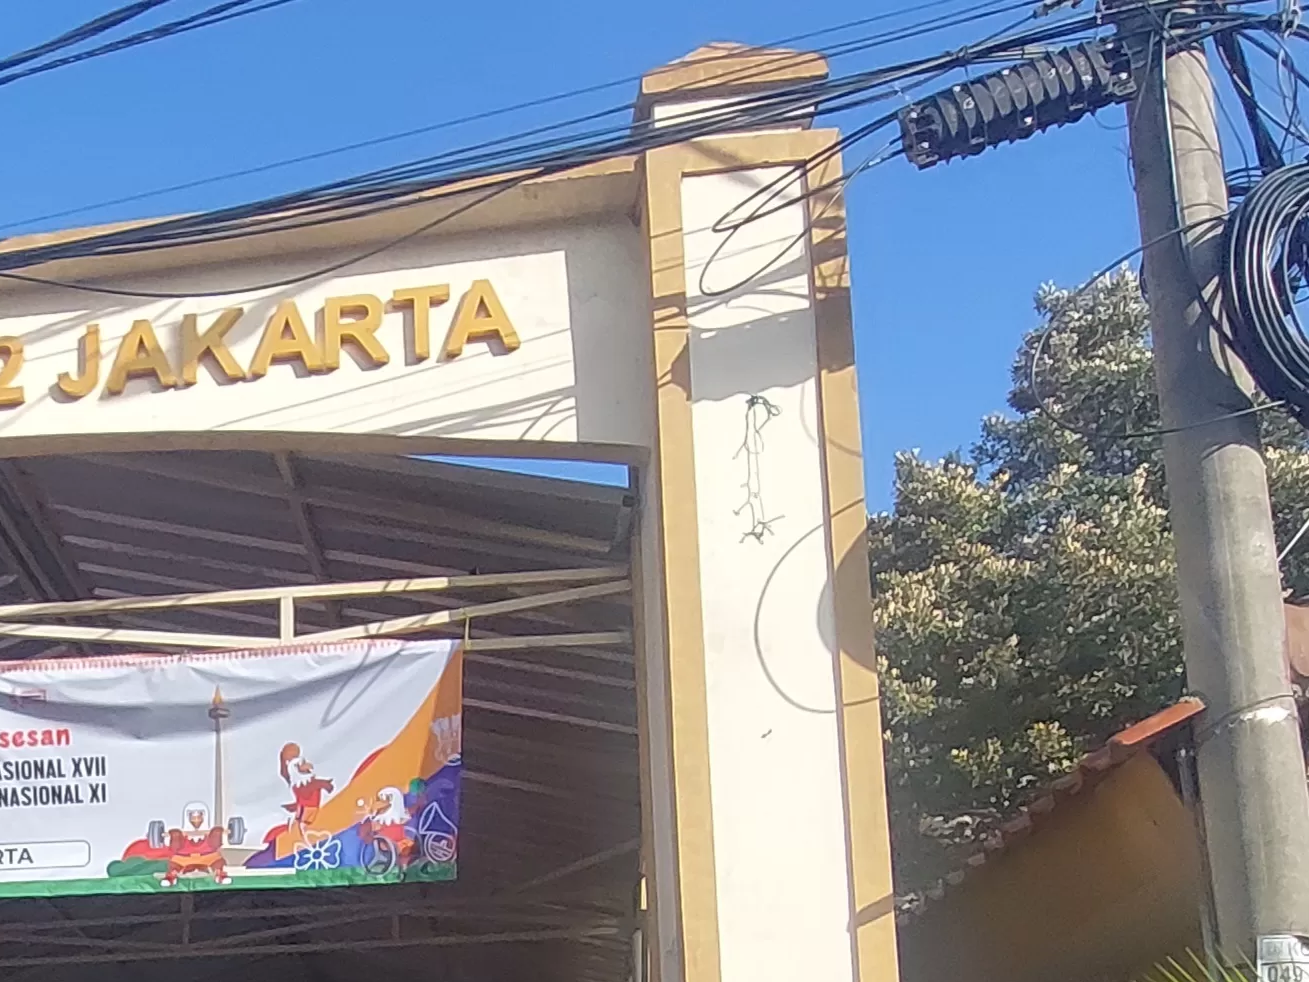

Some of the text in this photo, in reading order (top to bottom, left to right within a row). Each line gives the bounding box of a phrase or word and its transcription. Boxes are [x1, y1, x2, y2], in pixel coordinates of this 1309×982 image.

[56, 278, 521, 400] JAKARTA
[71, 756, 107, 779] XVII
[89, 782, 107, 803] XI
